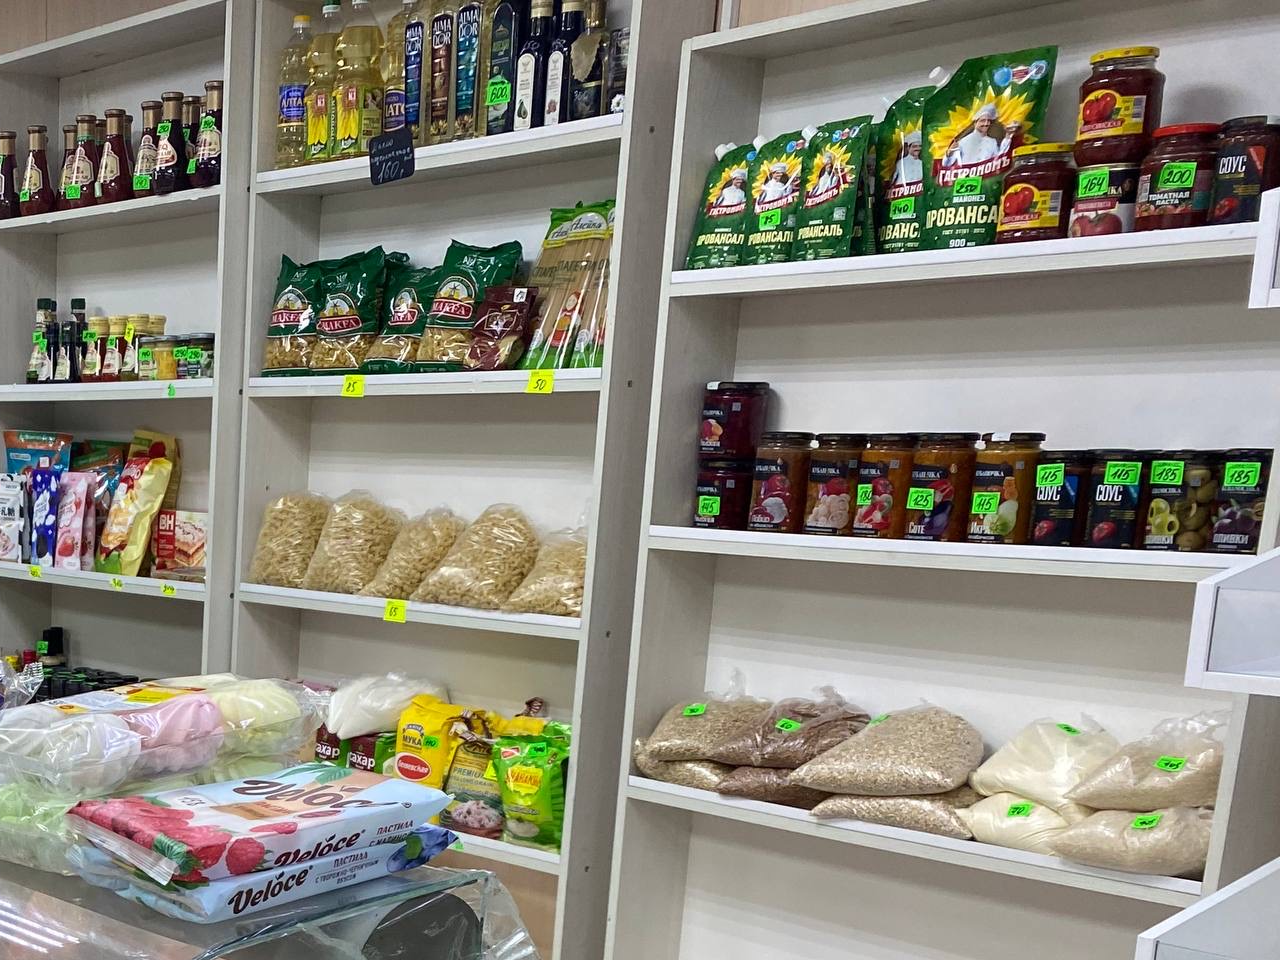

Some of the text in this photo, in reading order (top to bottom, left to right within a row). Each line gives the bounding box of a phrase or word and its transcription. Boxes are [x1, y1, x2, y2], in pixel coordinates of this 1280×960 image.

[939, 157, 1011, 185] ГАСТРОНОМЪ
[1219, 156, 1248, 174] СОУС
[1167, 169, 1192, 184] 200
[957, 185, 977, 194] 250
[1084, 177, 1104, 193] 164
[1150, 192, 1190, 201] ТОМАТНАЯ
[926, 205, 998, 229] ПРОВАНСА
[533, 378, 547, 390] 50
[1156, 467, 1178, 480] 185
[1230, 470, 1254, 485] 185
[1037, 488, 1060, 501] СОУС
[1096, 485, 1123, 501] СОУС
[913, 495, 929, 507] 125
[402, 734, 422, 746] МУКА
[316, 742, 340, 759] ахар
[376, 821, 414, 835] ПАСТИЛА
[333, 852, 368, 868] ПАСТИЛА
